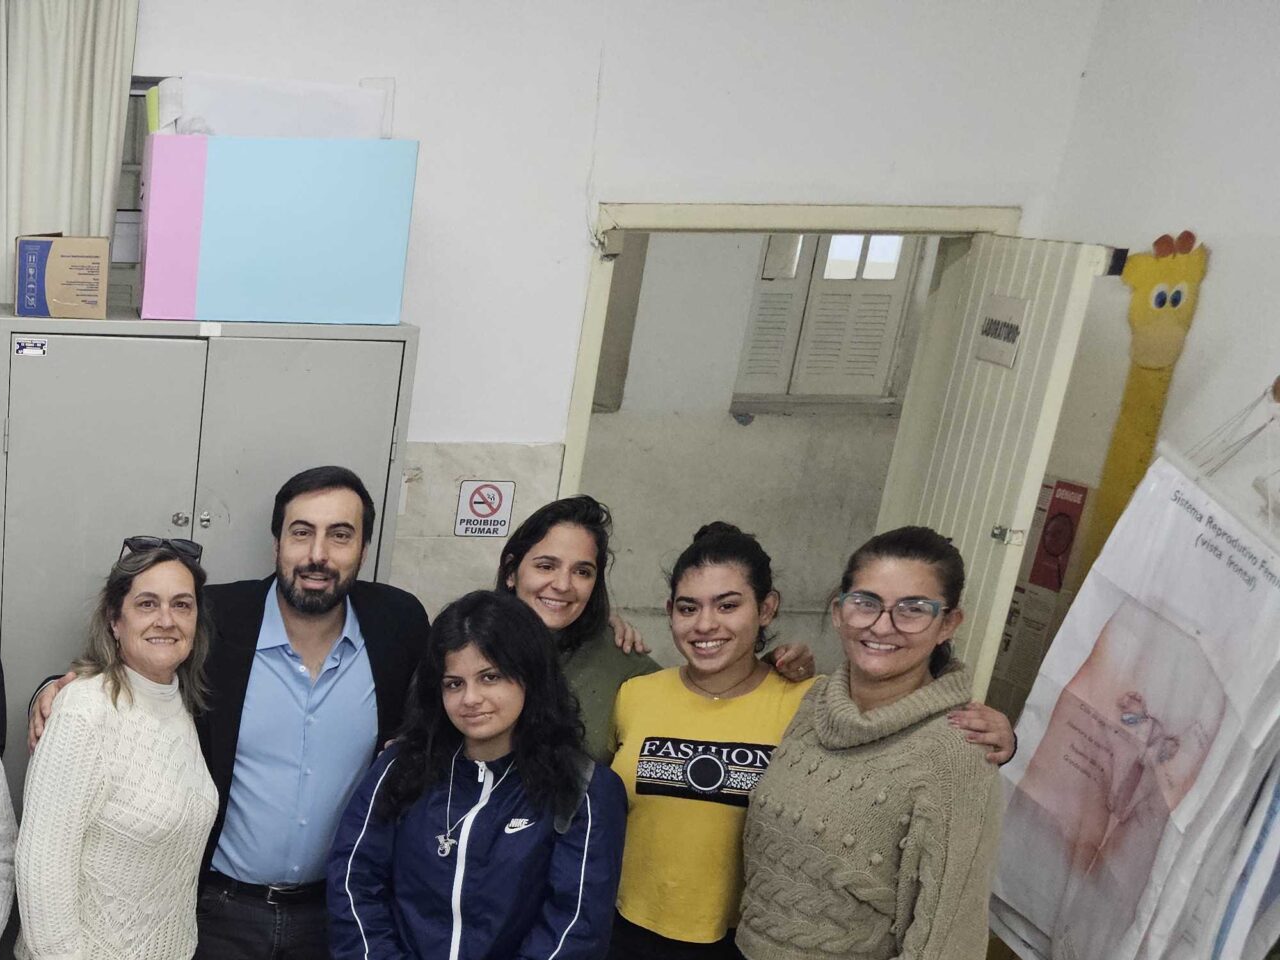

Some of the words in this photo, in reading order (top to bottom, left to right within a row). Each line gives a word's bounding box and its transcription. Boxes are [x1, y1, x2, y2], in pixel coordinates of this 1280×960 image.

[459, 518, 507, 527] PROIBIDO
[464, 526, 500, 535] FUMAR
[1171, 490, 1203, 522] Sistema
[1205, 516, 1258, 566] Reprodutivo
[1195, 533, 1222, 560] (vista
